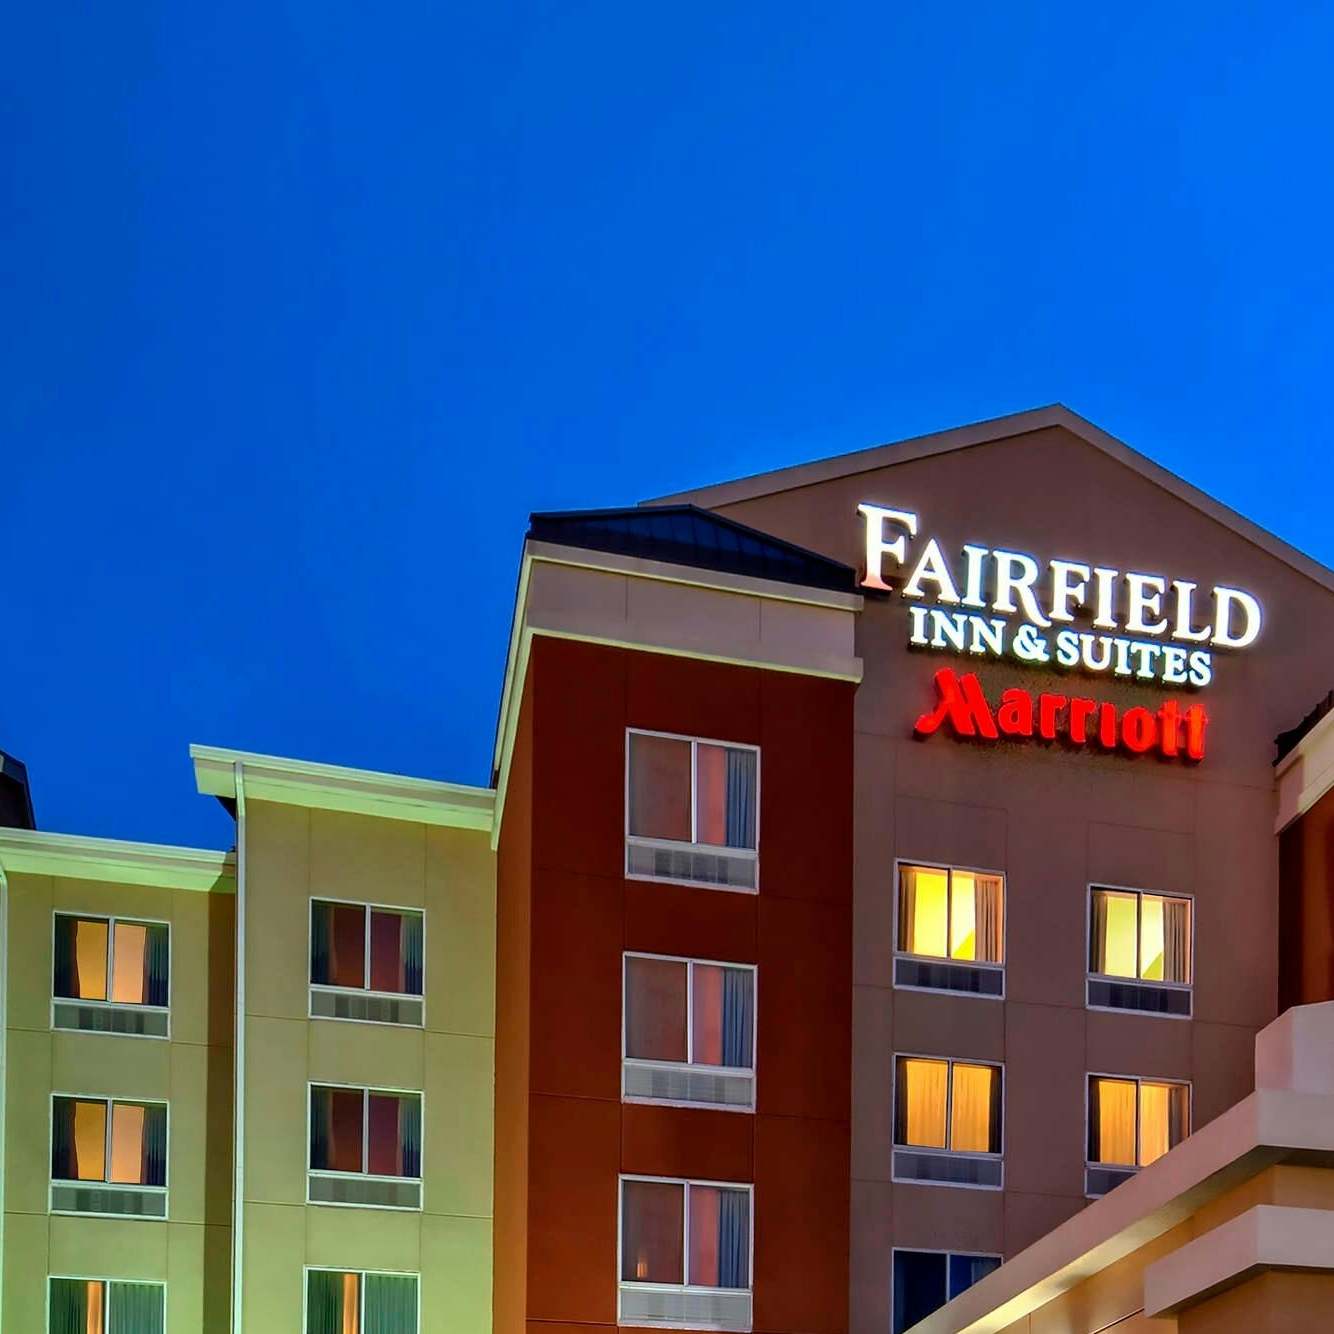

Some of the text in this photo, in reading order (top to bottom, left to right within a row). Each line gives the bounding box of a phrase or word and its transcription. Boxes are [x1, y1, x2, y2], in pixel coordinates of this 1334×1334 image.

[857, 503, 1263, 649] FAIRFIELD
[908, 606, 1213, 688] INN & SUITES
[914, 666, 1209, 762] Marriott
